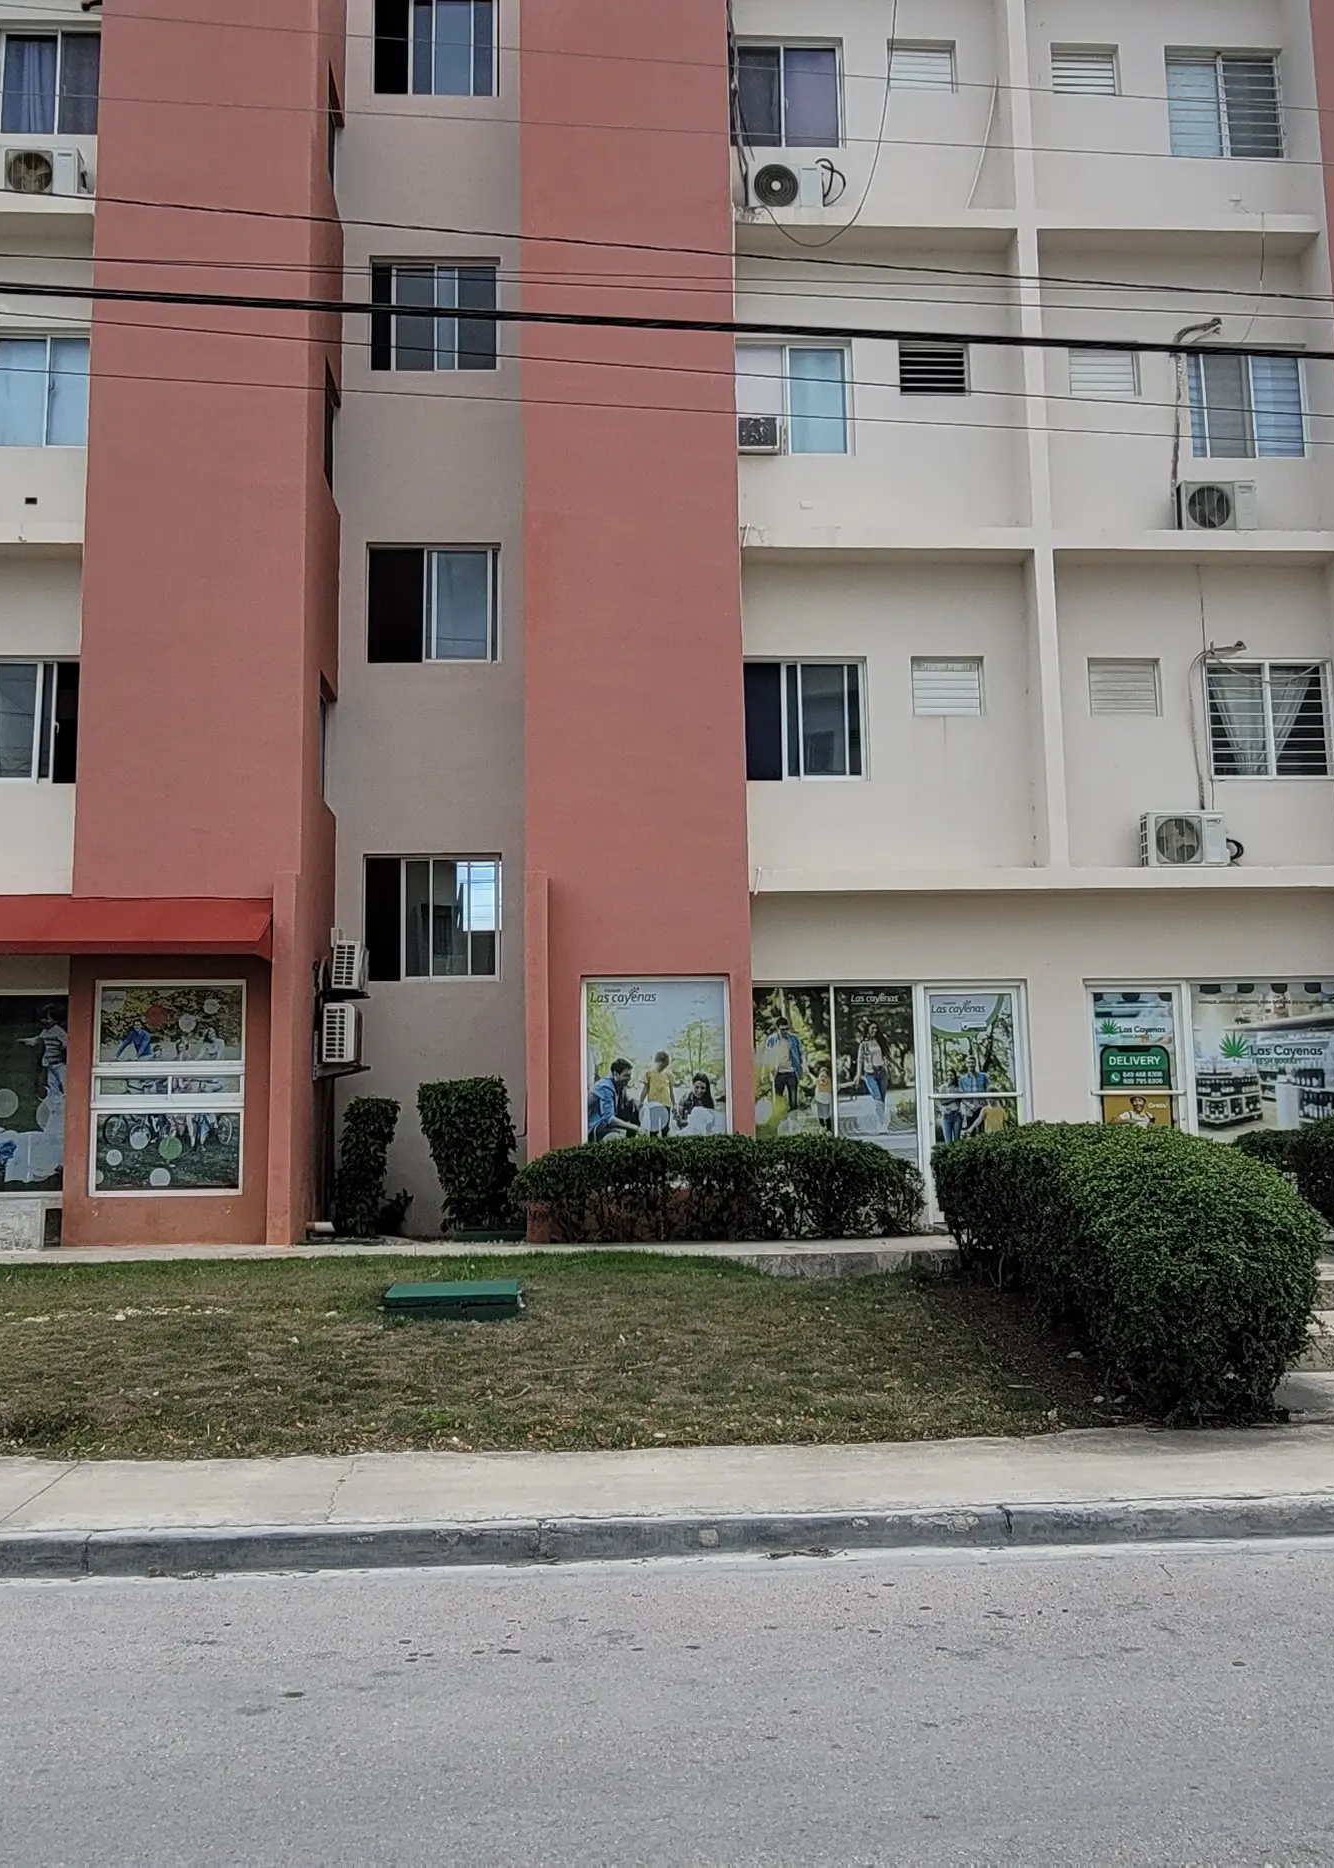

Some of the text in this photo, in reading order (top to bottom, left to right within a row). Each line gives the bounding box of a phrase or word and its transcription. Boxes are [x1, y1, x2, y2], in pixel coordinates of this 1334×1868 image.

[590, 989, 657, 1006] Las cayenas
[850, 994, 865, 1002] Las
[931, 1003, 986, 1016] Las cayenas
[1119, 1025, 1166, 1035] Las Cayenas
[1250, 1044, 1323, 1059] Las Cayenas
[1108, 1056, 1161, 1066] DELIVERY
